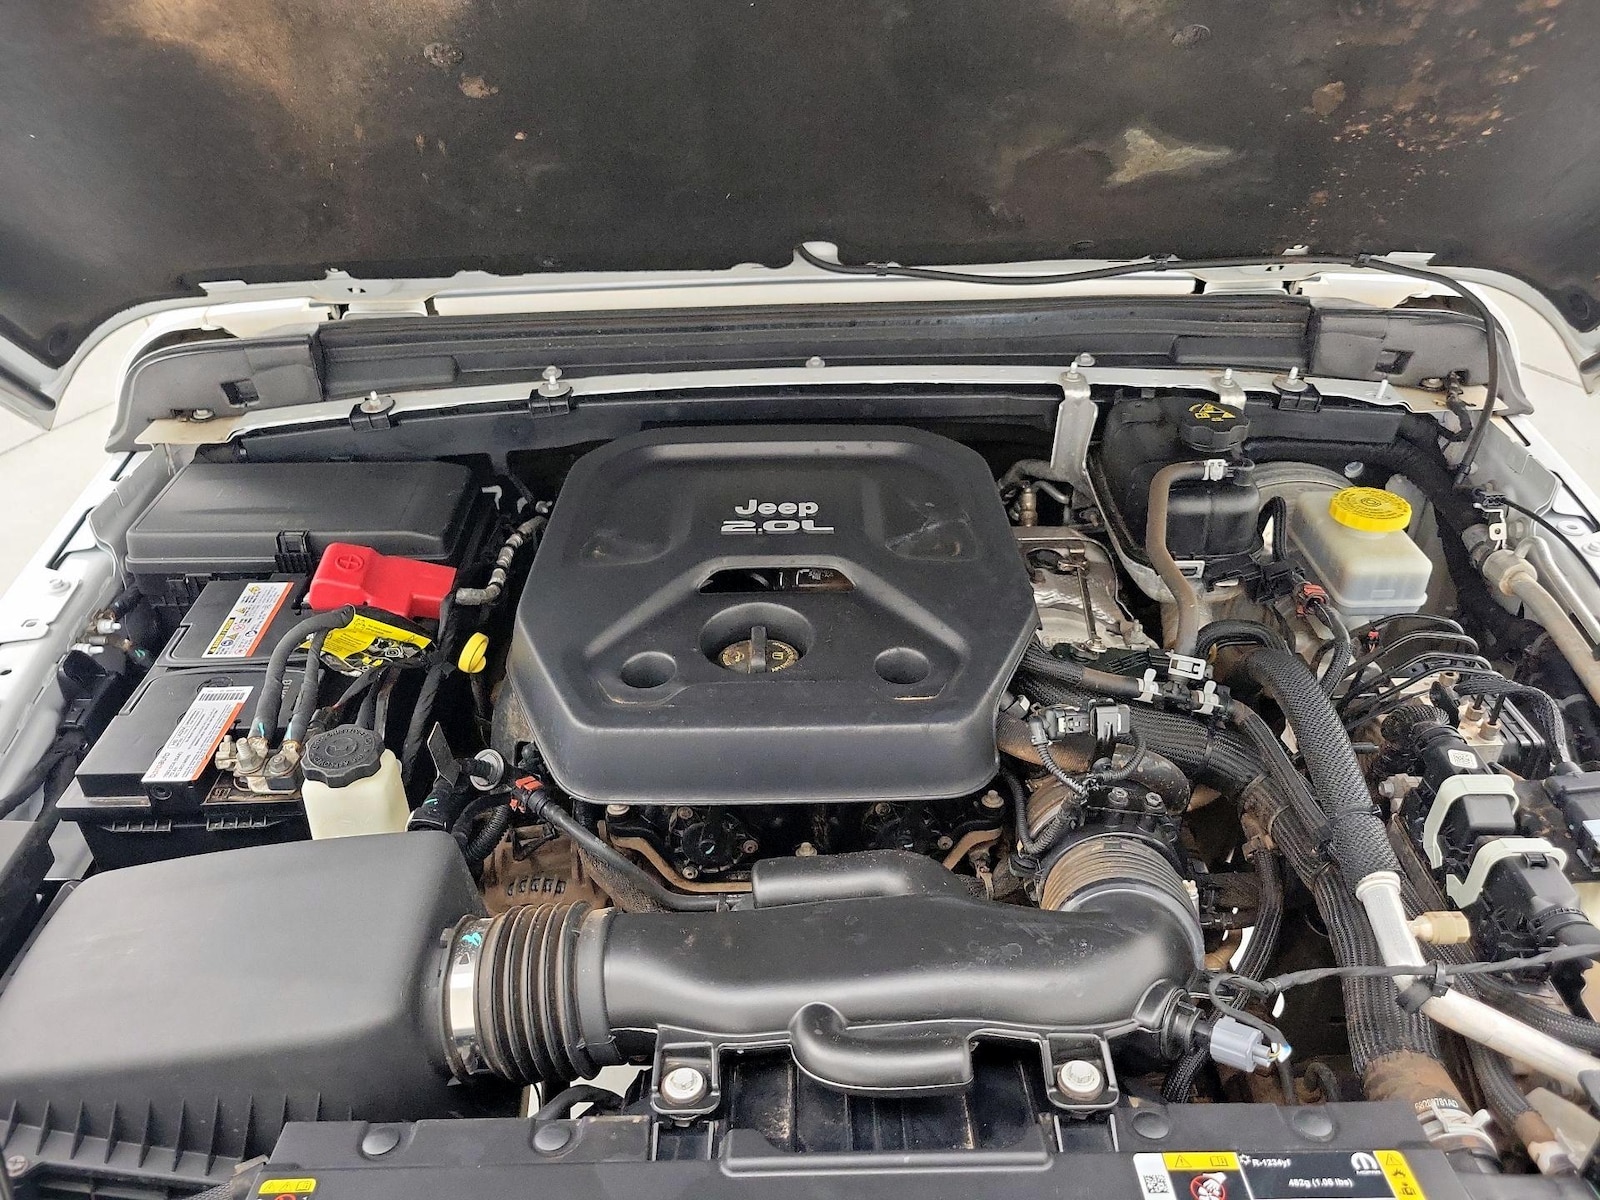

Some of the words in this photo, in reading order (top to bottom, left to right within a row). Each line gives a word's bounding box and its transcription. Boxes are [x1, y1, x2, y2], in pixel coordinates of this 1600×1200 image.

[735, 499, 819, 517] Jeep
[720, 520, 835, 534] 2.0L
[1251, 1158, 1291, 1169] R-1234yf
[1334, 1178, 1354, 1188] lbs)
